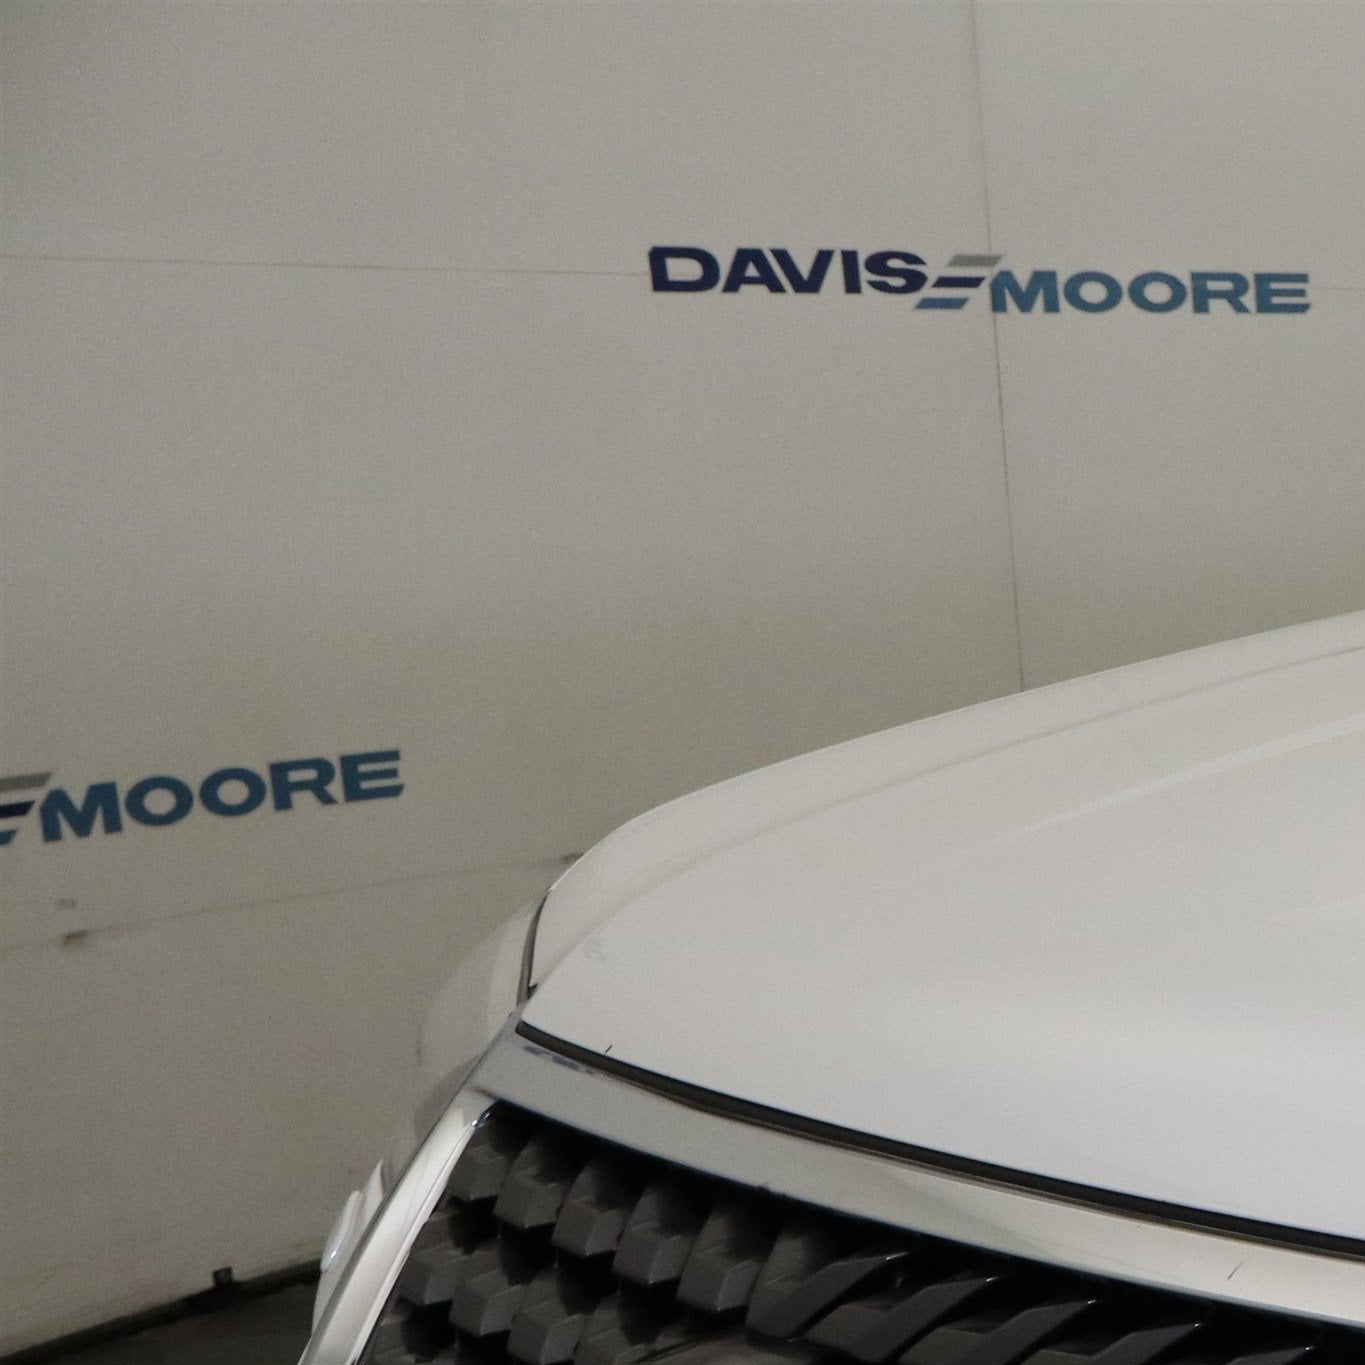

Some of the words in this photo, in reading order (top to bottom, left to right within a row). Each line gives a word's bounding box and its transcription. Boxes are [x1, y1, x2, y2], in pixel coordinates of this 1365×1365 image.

[648, 246, 928, 294] DAVIS
[989, 269, 1311, 314] MOORE
[40, 749, 404, 842] MOORE
